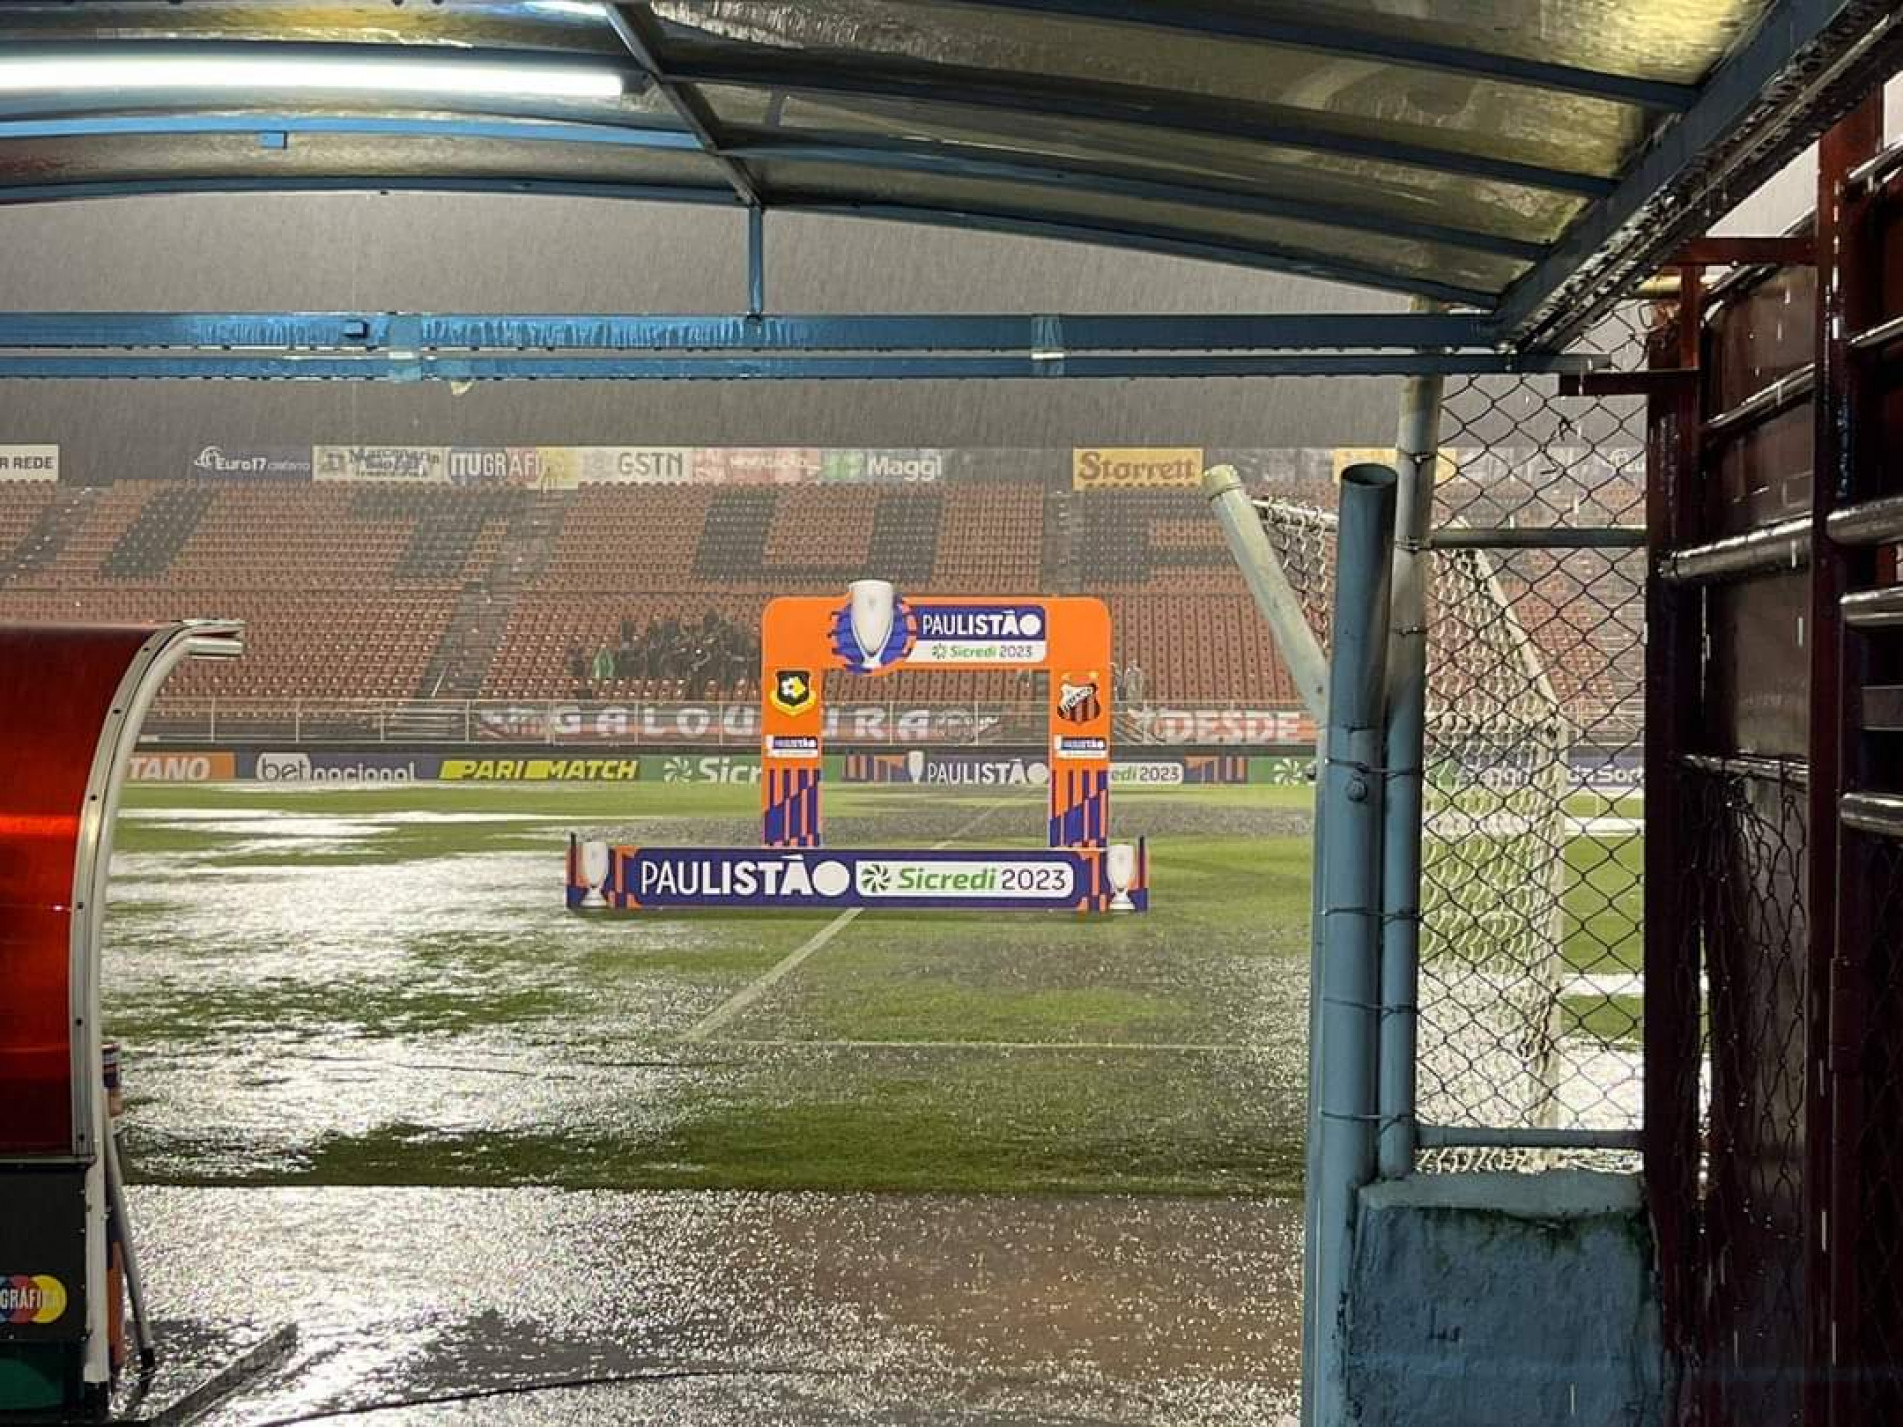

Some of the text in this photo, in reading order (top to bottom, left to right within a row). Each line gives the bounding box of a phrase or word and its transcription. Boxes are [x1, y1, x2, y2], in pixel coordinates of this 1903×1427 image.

[617, 452, 683, 477] GSTN
[922, 608, 1041, 636] PAULISTÃO
[950, 645, 1032, 658] Sicredi 2023
[129, 756, 211, 781] TANO
[698, 756, 762, 784] Sicr
[927, 757, 1049, 784] PAULISTÃO
[1139, 766, 1180, 781] 2023
[641, 854, 1066, 897] PAULISTÃO Sicredi 2023
